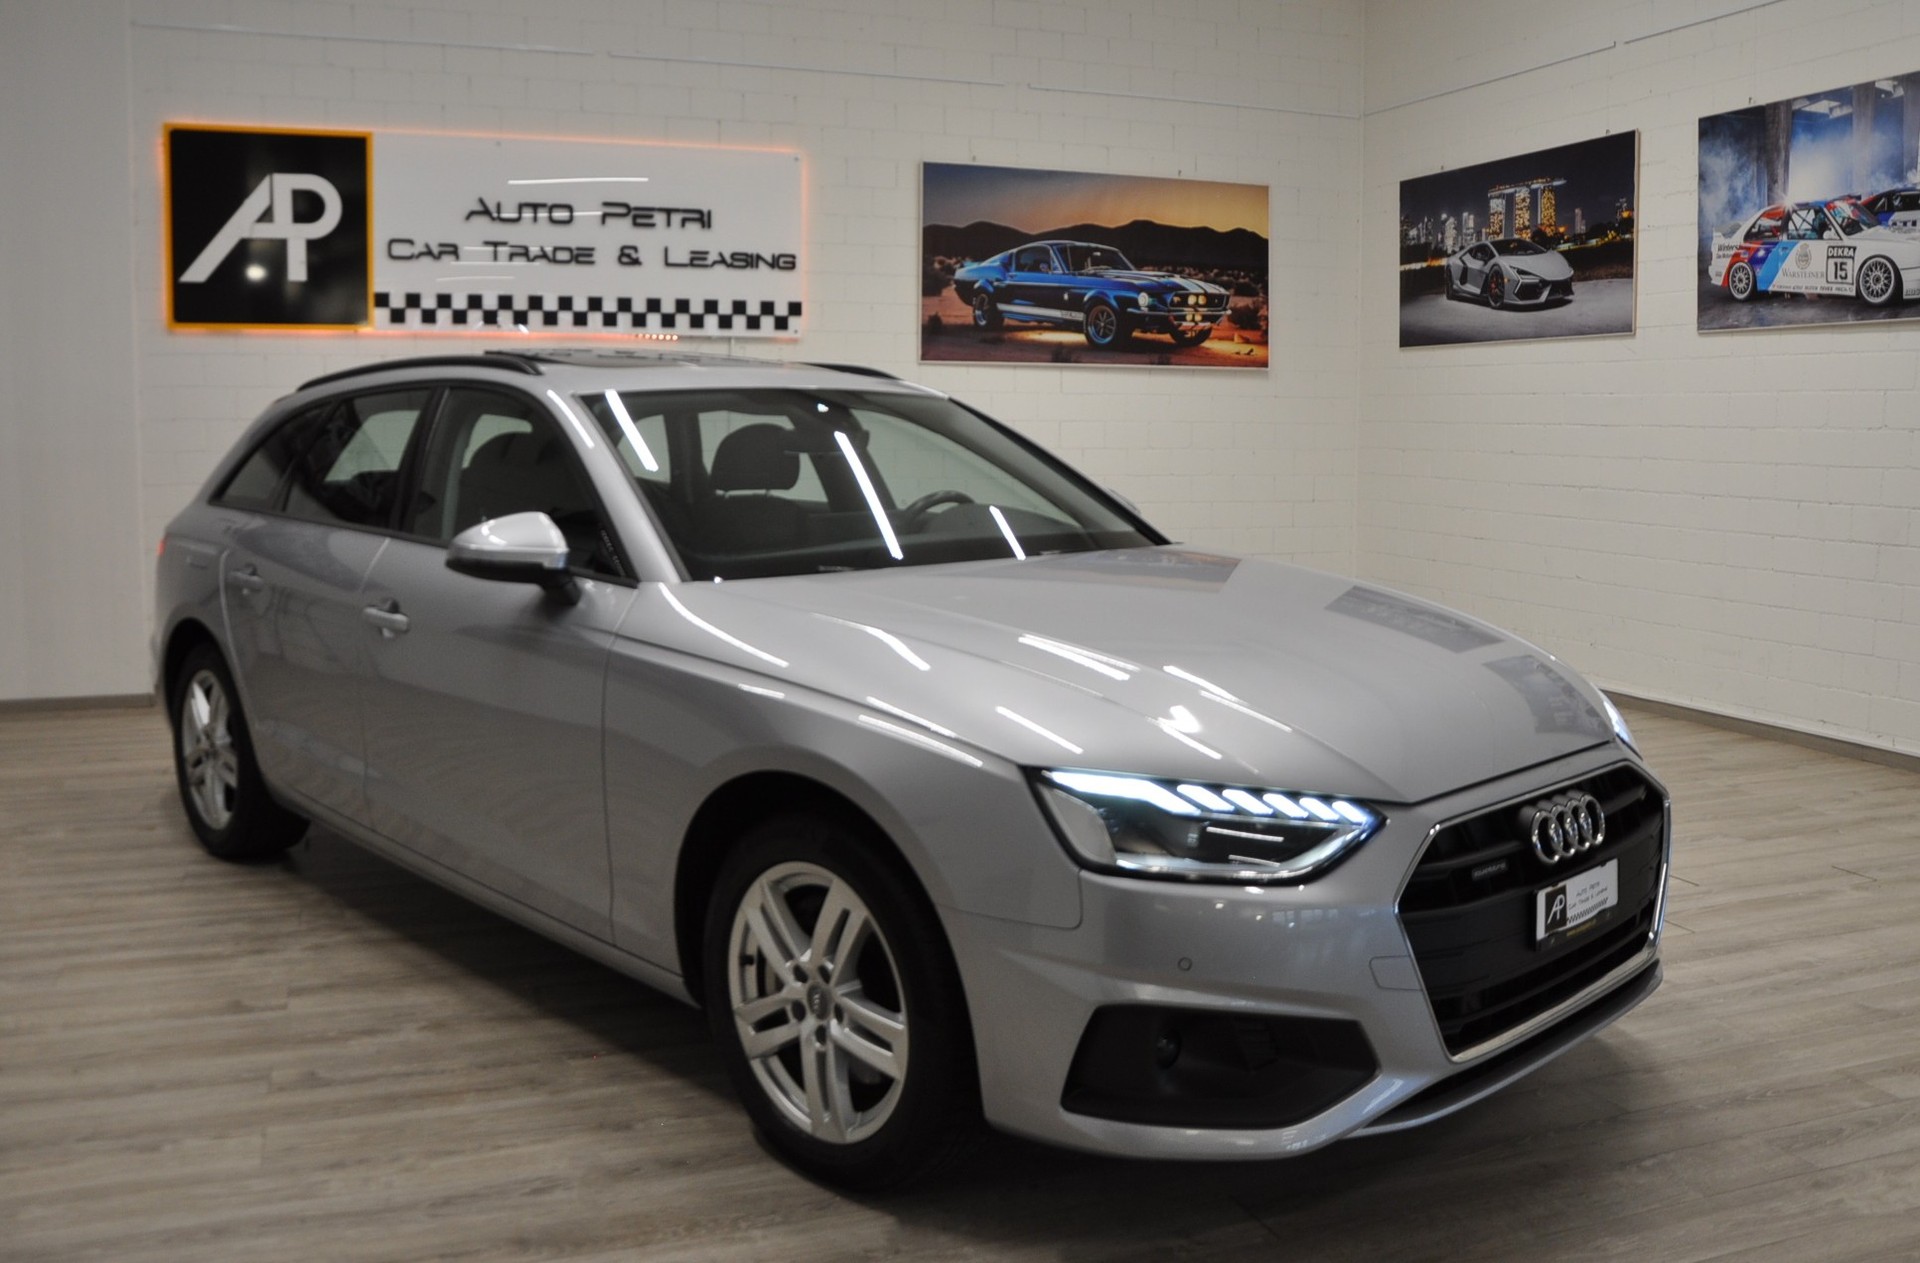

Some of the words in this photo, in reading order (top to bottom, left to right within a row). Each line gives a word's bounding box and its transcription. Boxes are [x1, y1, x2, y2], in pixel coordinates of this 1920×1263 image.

[179, 173, 343, 283] AP
[465, 197, 574, 224] AUTO
[601, 202, 711, 229] PETRI
[388, 238, 460, 261] CAR
[482, 241, 596, 265] TRADE
[618, 245, 642, 266] &
[664, 246, 796, 270] LEASING
[1828, 247, 1855, 257] DEKRA
[1834, 261, 1848, 280] 15
[1547, 894, 1565, 925] AP
